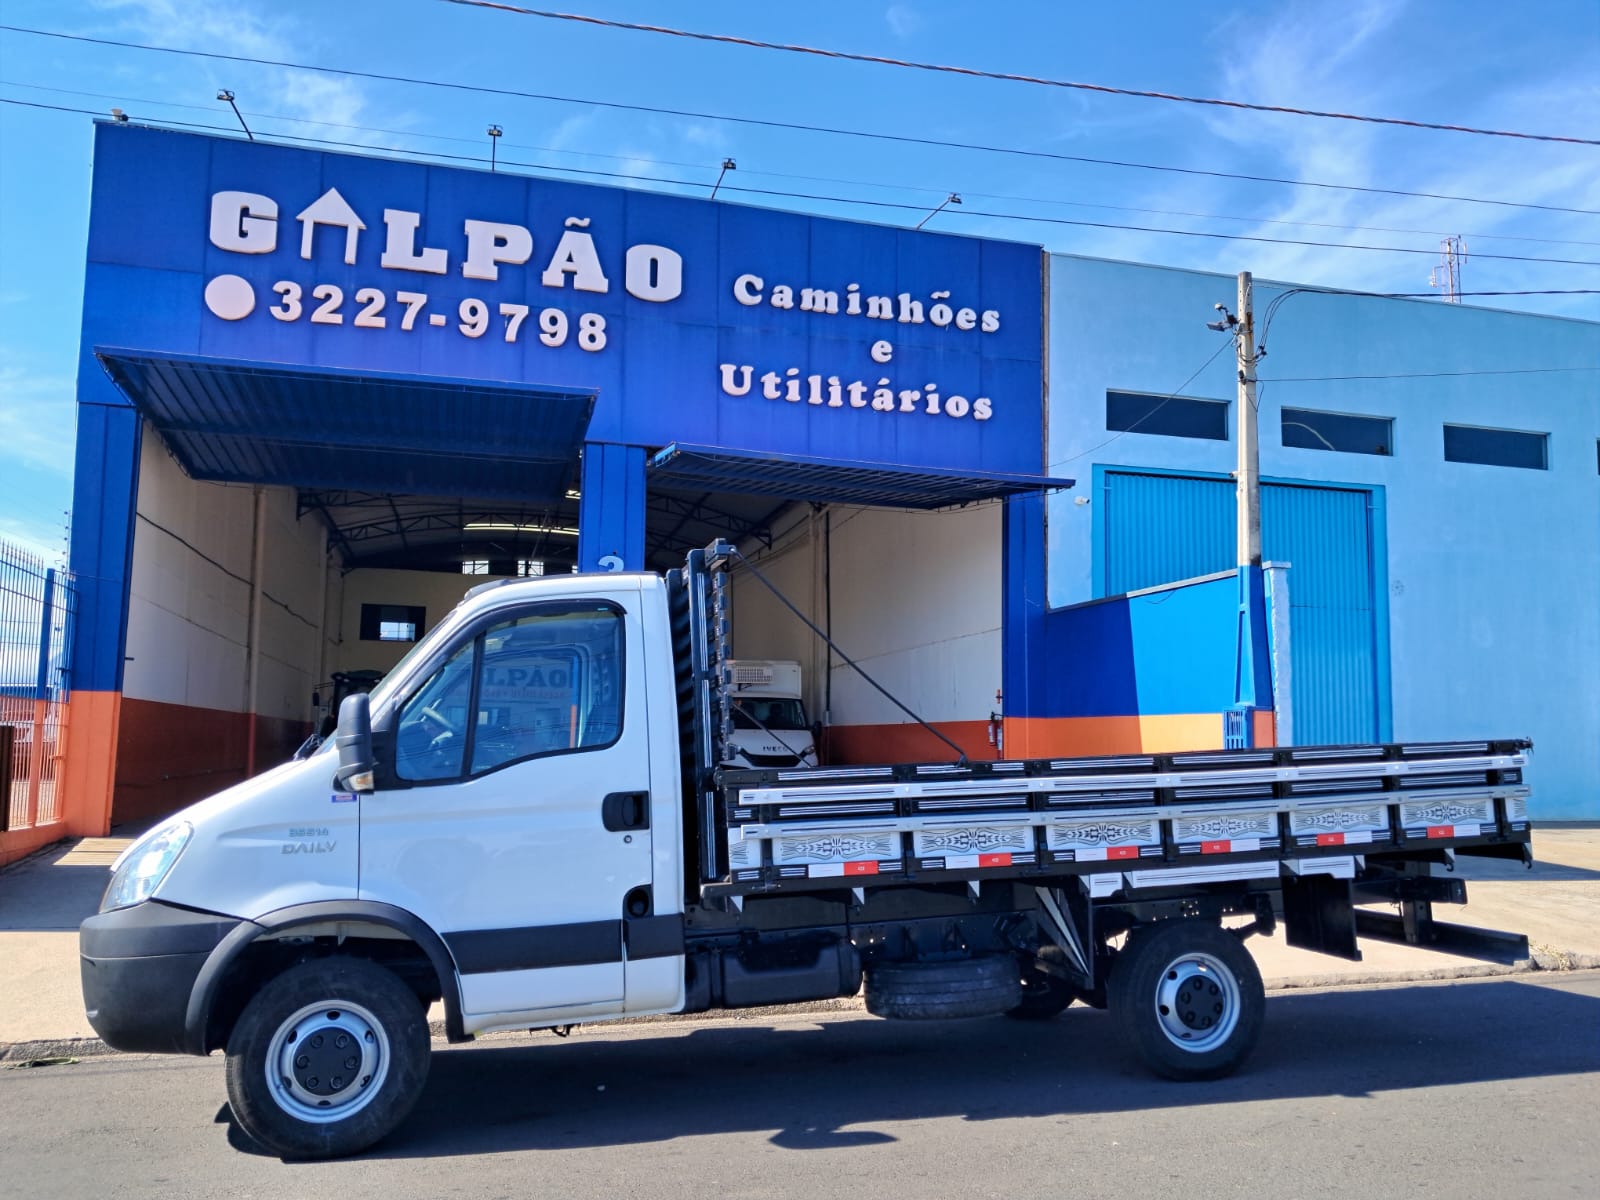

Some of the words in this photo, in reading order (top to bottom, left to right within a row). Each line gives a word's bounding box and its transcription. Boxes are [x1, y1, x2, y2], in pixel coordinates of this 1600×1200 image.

[269, 280, 608, 352] 3227-9798
[733, 273, 1001, 333] Caminhões
[871, 339, 894, 363] e
[719, 363, 993, 420] Utilitários
[281, 841, 337, 855] DAILY
